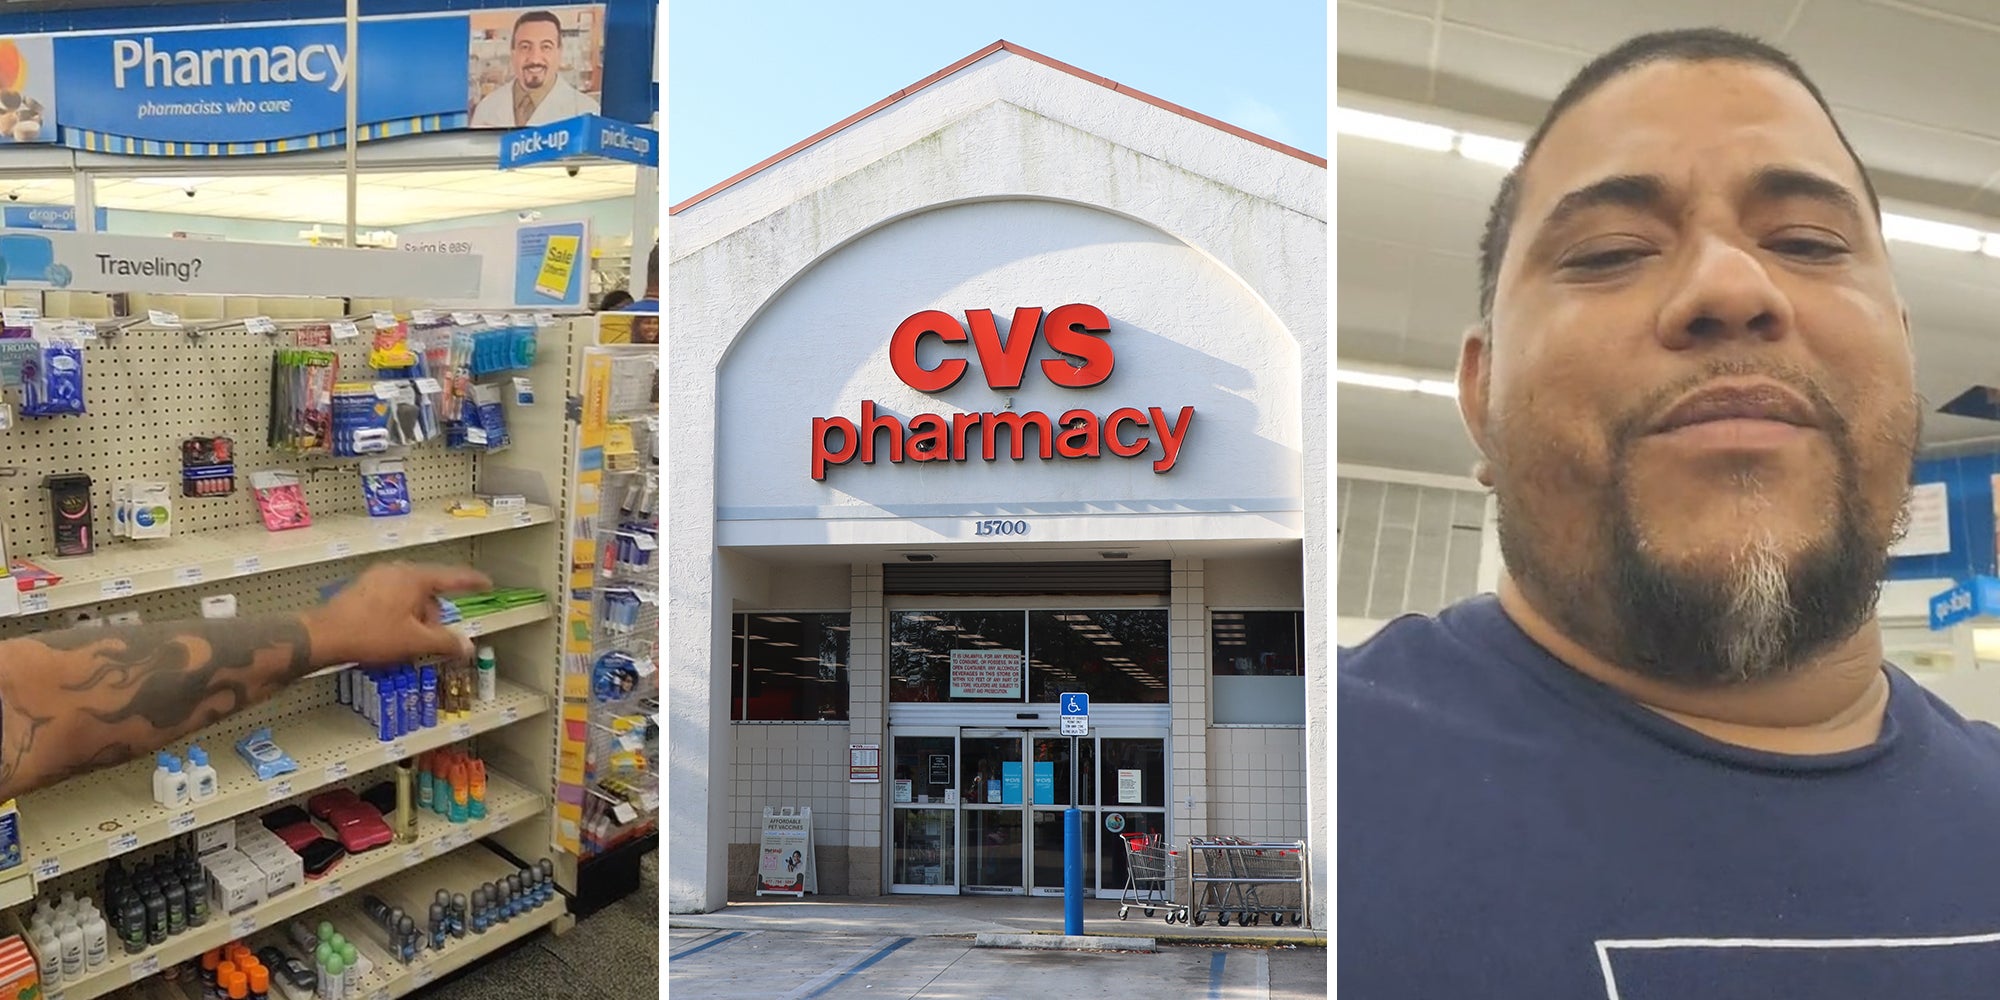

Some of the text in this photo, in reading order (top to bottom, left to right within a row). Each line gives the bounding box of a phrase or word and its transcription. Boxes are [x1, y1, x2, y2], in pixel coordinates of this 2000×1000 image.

[113, 37, 348, 93] Pharmacy
[138, 98, 292, 119] pharmacists who care
[511, 129, 570, 162] pick-up
[601, 126, 650, 157] pick-up
[29, 208, 76, 225] drop-of
[449, 240, 473, 255] easy
[547, 246, 572, 265] Sale
[95, 253, 202, 281] Traveling?
[888, 302, 1115, 394] CVS
[811, 399, 1195, 481] pharmacy
[975, 520, 1027, 535] 15700
